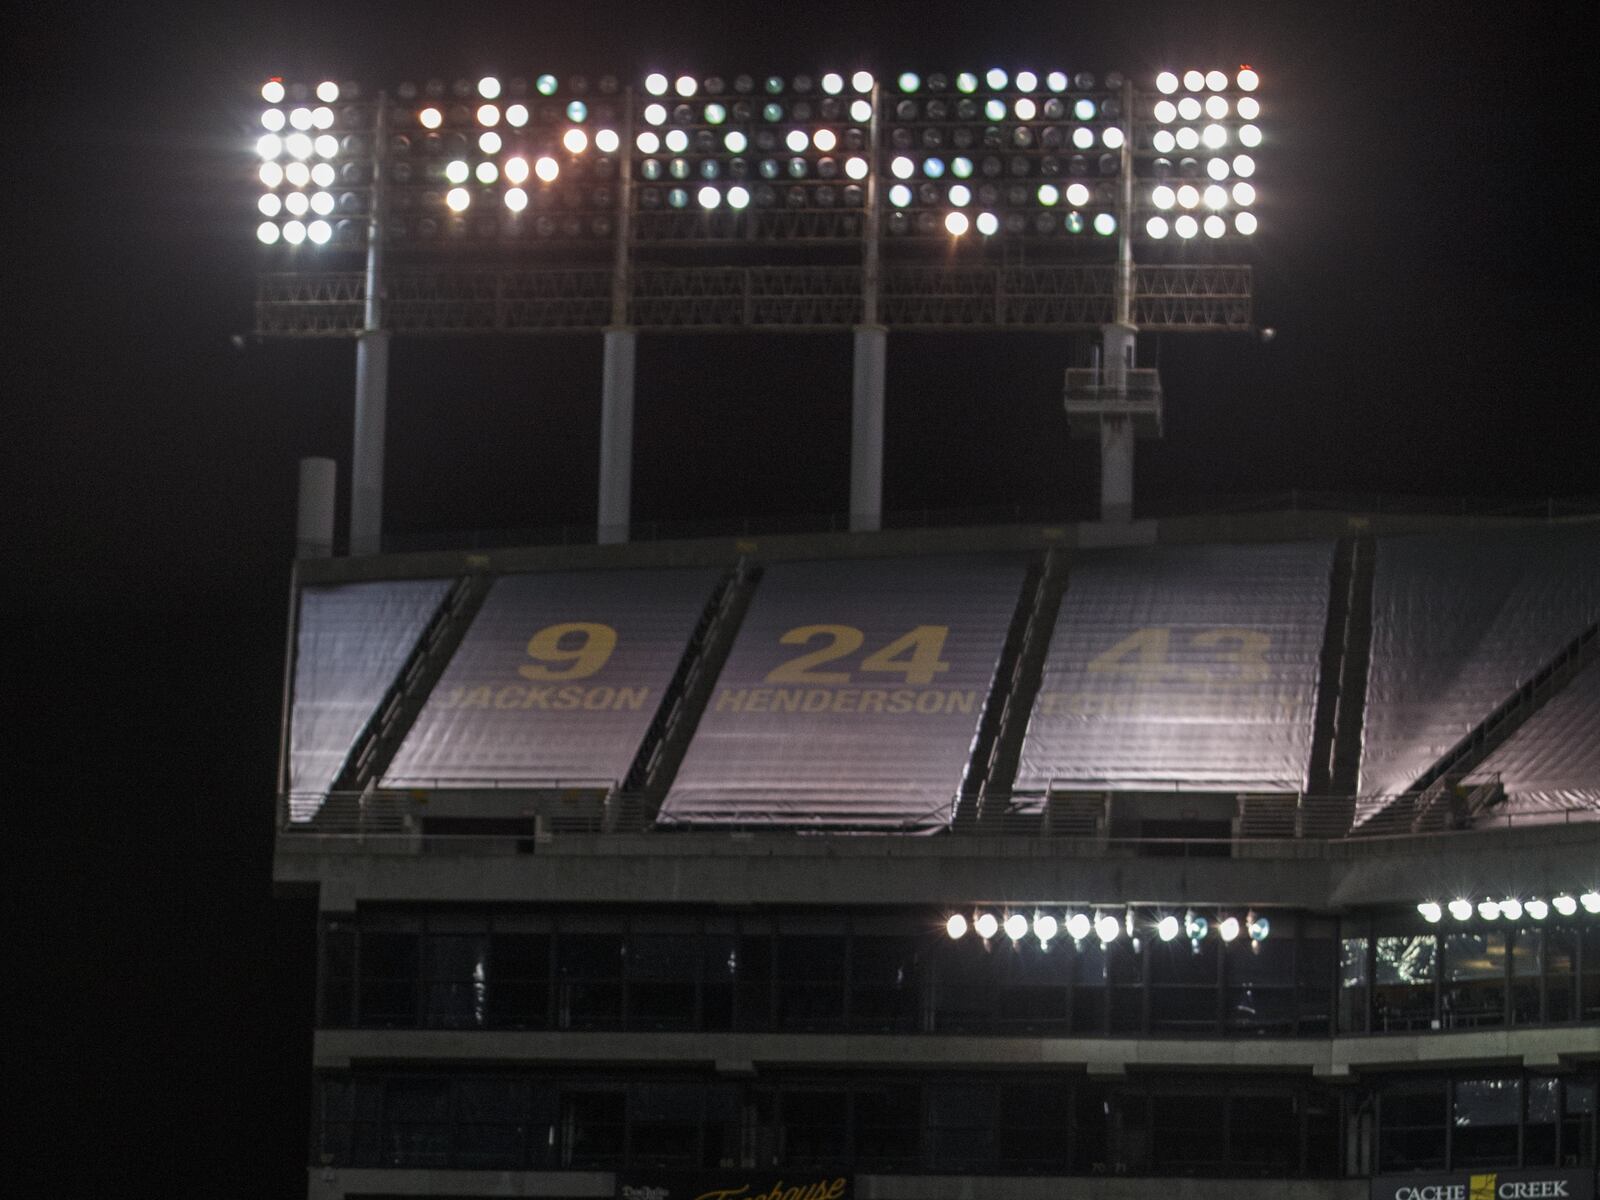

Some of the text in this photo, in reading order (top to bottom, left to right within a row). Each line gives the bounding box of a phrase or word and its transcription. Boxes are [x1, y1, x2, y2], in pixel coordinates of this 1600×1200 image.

[518, 621, 617, 681] 9
[763, 623, 951, 686] 24
[1088, 627, 1273, 682] 43
[446, 685, 650, 712] JACKSON
[714, 687, 976, 716] HENDERSON
[1498, 1180, 1569, 1200] CREEK
